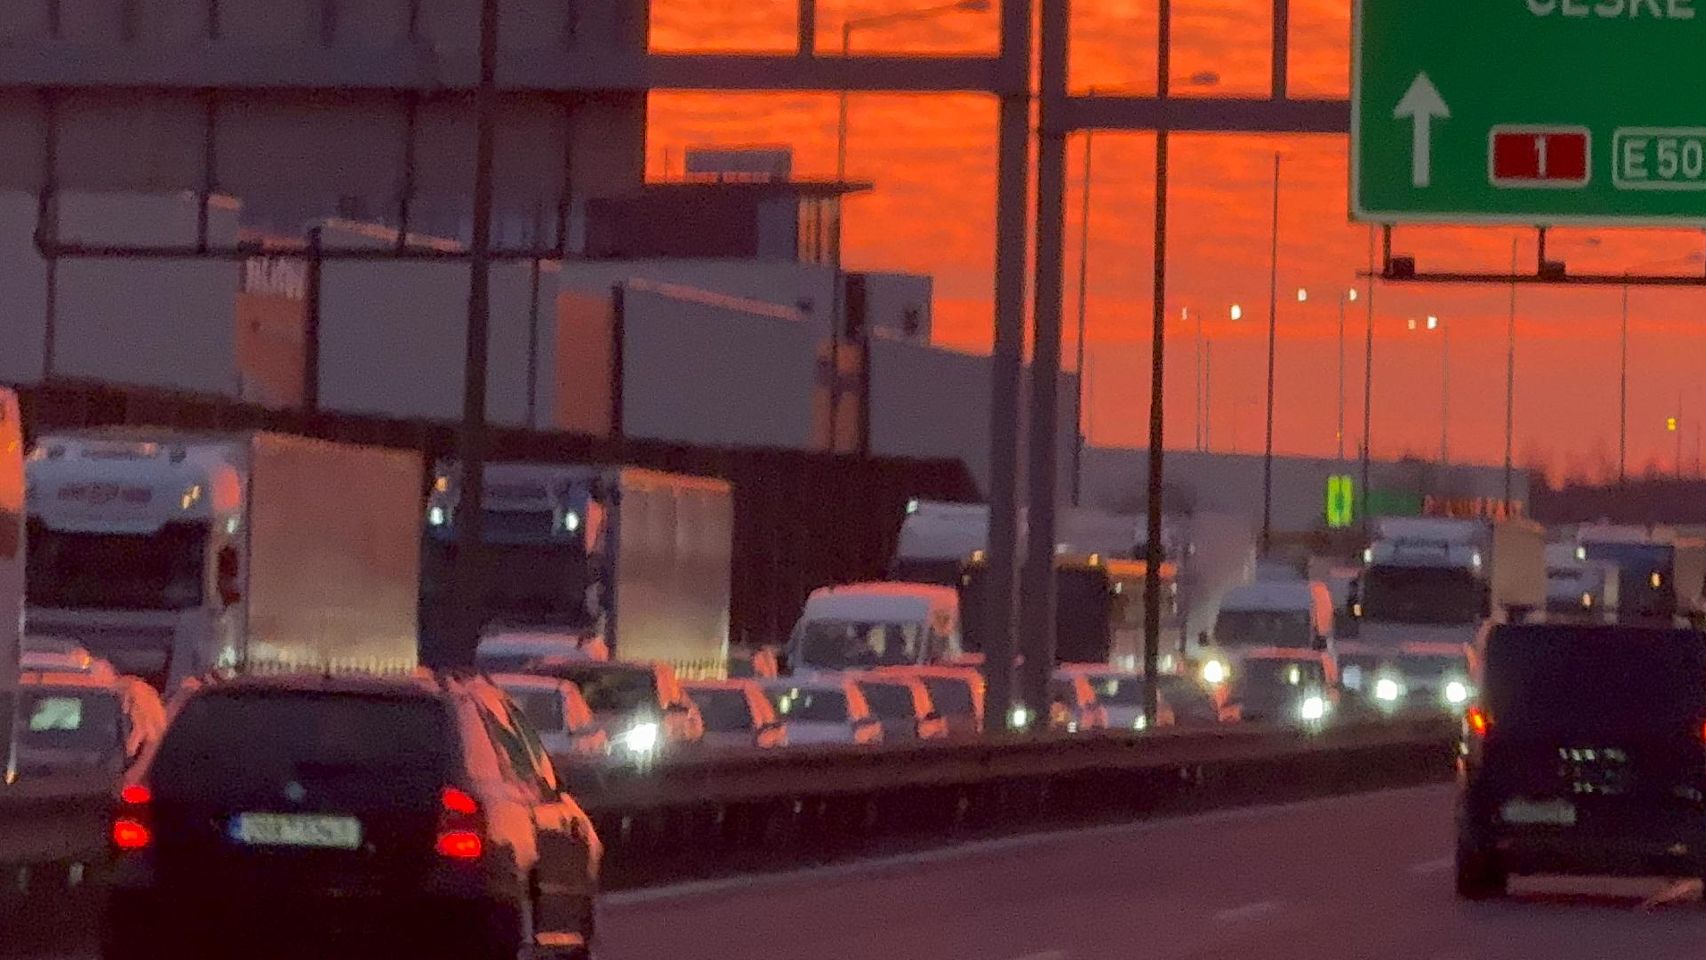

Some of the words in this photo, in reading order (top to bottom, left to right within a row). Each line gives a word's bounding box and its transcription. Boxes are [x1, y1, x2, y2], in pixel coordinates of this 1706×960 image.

[1533, 135, 1549, 178] 1
[1621, 139, 1644, 178] E
[1656, 138, 1704, 179] 50
